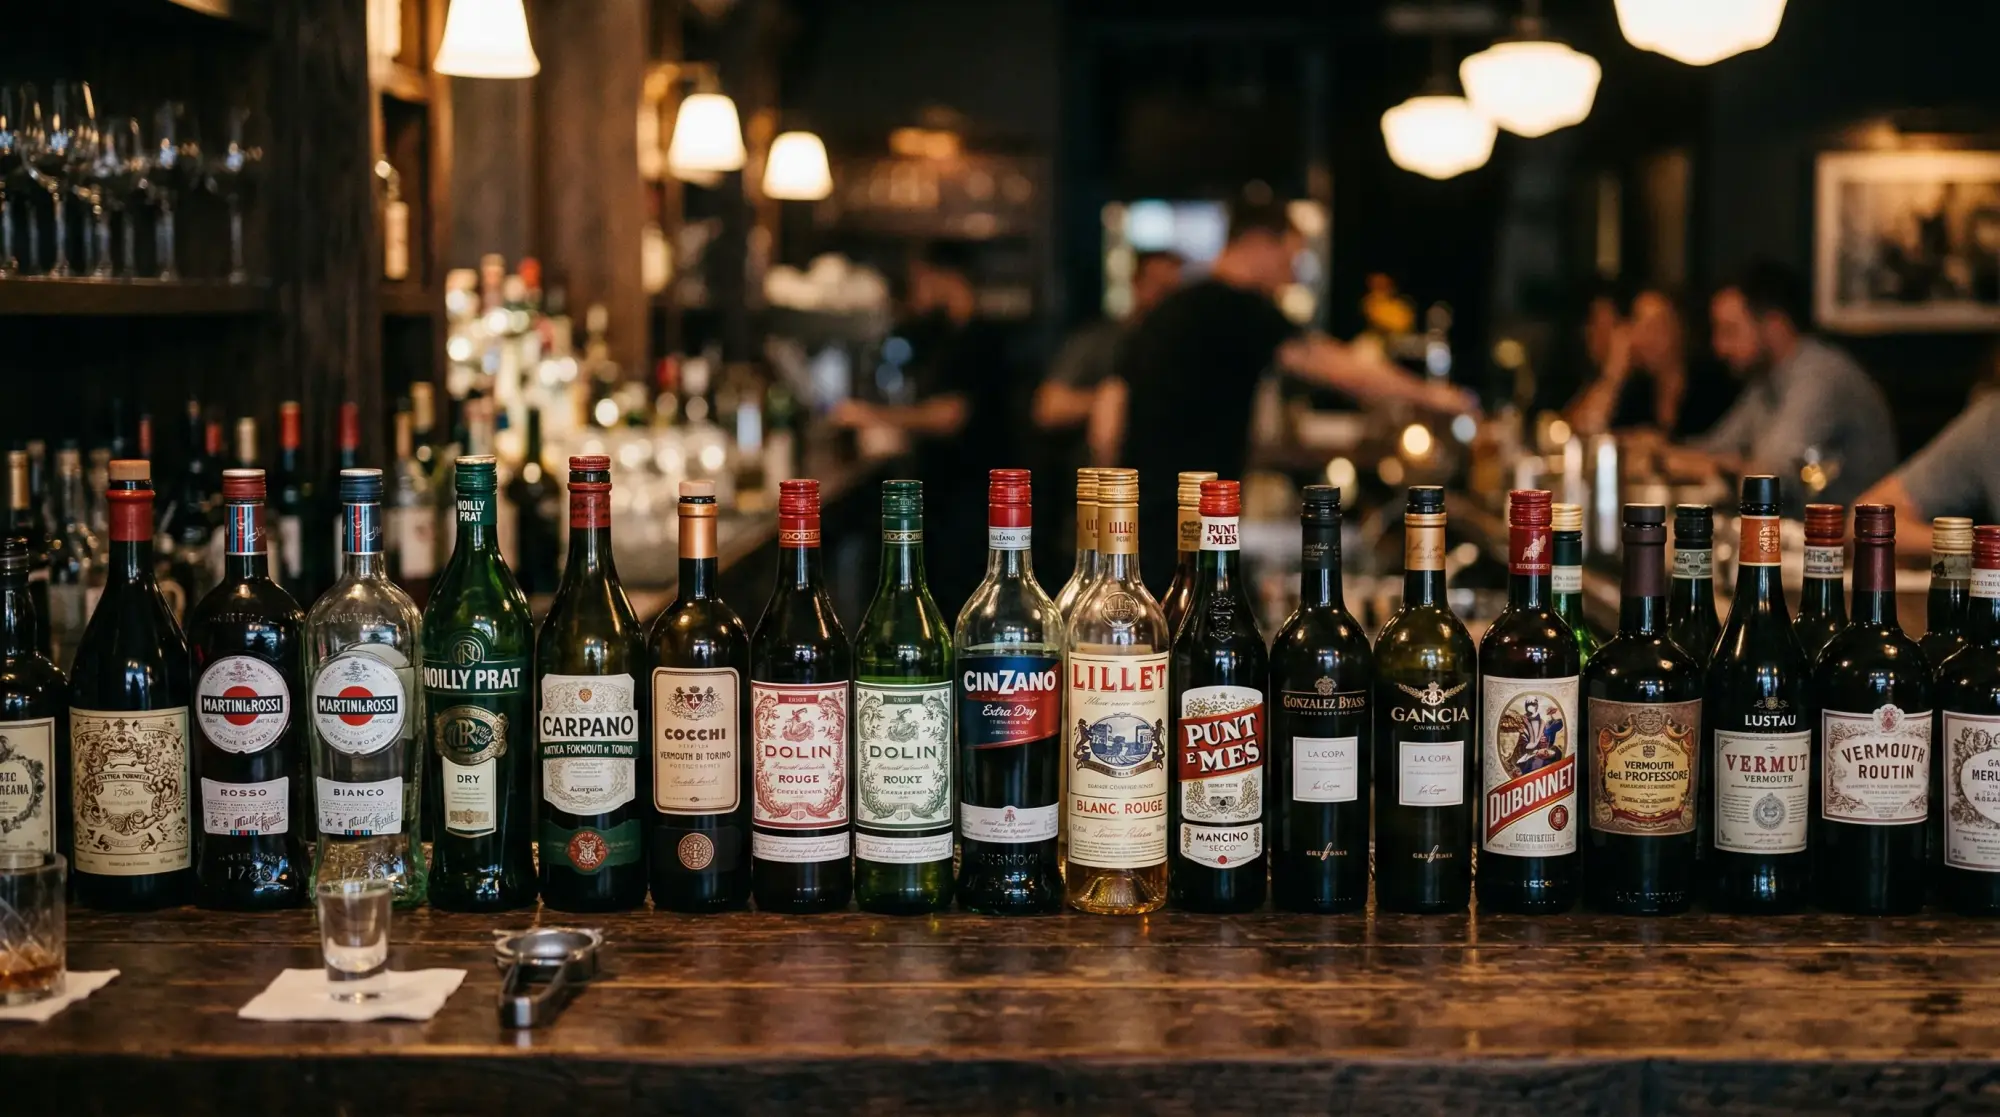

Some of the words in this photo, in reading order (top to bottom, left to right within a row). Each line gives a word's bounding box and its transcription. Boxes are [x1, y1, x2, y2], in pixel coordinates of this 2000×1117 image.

[457, 500, 485, 511] NOILLY
[460, 511, 482, 521] PRAT
[1208, 524, 1236, 535] PUNT
[1212, 535, 1237, 545] MES
[423, 667, 471, 690] NOILLY
[474, 667, 521, 690] PRAT
[963, 669, 1056, 695] CINZANO
[1072, 663, 1166, 692] LILLET
[1283, 695, 1336, 709] GONZALEZ
[1338, 695, 1366, 709] BYASS
[981, 704, 1013, 717] Extra
[1014, 704, 1037, 721] Dry
[1390, 706, 1470, 723] GANCIA
[542, 716, 634, 738] CARPANO
[1744, 714, 1797, 727] LUSTAU
[664, 727, 726, 741] COCCHI
[1184, 713, 1257, 748] PUNT
[660, 750, 693, 761] VERMOUTH
[706, 751, 732, 761] TORINO
[765, 745, 832, 759] DOLIN
[869, 745, 937, 759] DOLIN
[1186, 752, 1197, 765] E
[1198, 739, 1261, 773] MES
[1308, 750, 1319, 758] LA
[1321, 750, 1345, 758] COPA
[1841, 742, 1926, 764] VERMOUTH
[1624, 760, 1674, 770] VERMOUTH
[1725, 753, 1808, 773] VERMUT
[456, 774, 480, 784] DRY
[778, 774, 820, 784] ROUGE
[1625, 769, 1689, 781] PROFESSORE
[1858, 764, 1914, 780] ROUTIN
[112, 787, 135, 799] 1786
[220, 788, 267, 797] ROSSO
[333, 788, 385, 797] BIANCO
[1489, 762, 1574, 829] DUBONNET
[1124, 799, 1163, 815] ROUGE
[1196, 831, 1249, 843] MANCINO
[1208, 844, 1237, 852] SECCO
